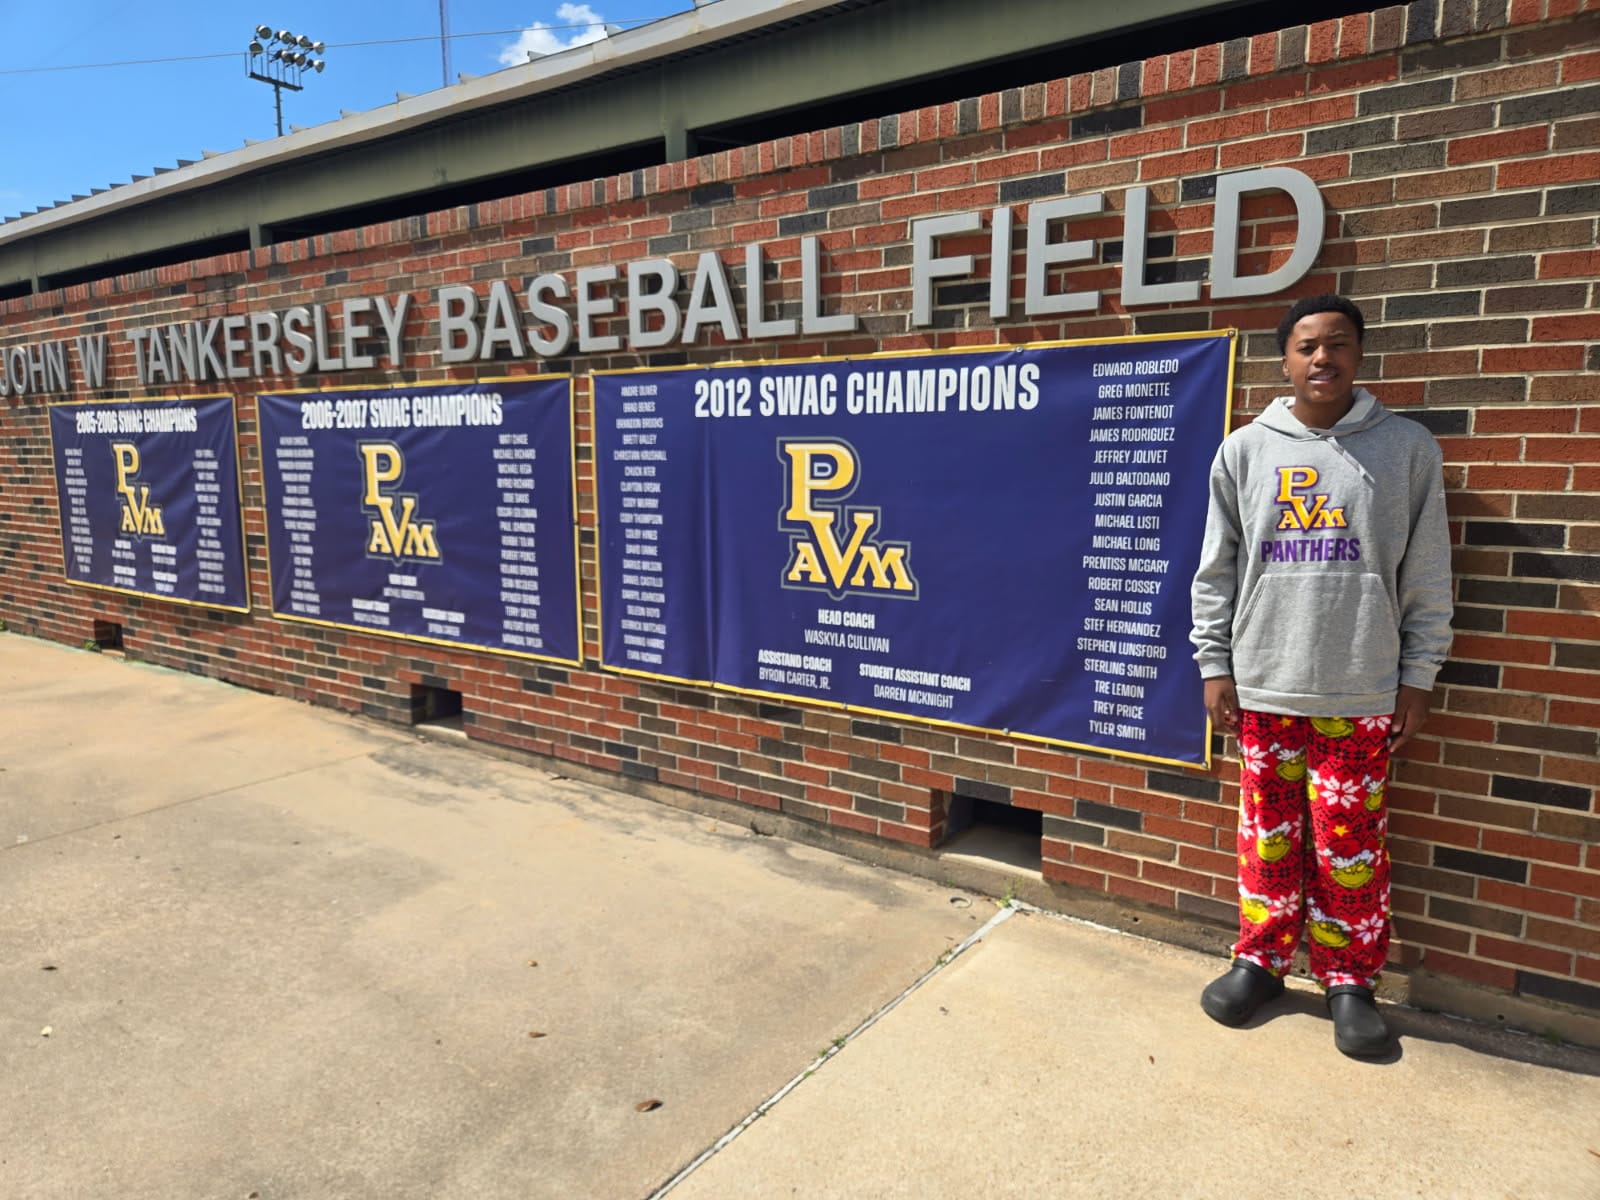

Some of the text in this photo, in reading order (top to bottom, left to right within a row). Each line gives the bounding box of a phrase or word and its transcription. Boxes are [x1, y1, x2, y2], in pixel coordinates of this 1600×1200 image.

[0, 166, 1327, 396] JOHN W TANKERSLEY BASEBALL FIELD
[1093, 358, 1180, 378] EDWARD ROBLEDO
[694, 362, 1041, 418] 2012 SWAC CHAMPIONS
[1099, 382, 1170, 399] GREG MONETTE
[118, 409, 144, 434] SWAC
[144, 407, 198, 433] CHAMPIONS
[301, 392, 503, 430] 2006-2007 SWAC CHAMPIONS
[1093, 404, 1175, 421] JAMES FONTENOT
[1089, 426, 1176, 442] JAMES RODRIGUEZ
[1094, 449, 1168, 464] JEFFREY JOLIVET
[1089, 471, 1171, 486] JULIO BALTODANO
[1094, 492, 1163, 508] JUSTIN GARCIA
[1095, 513, 1160, 530] MICHAEL LISTI
[1093, 534, 1161, 552] MICHAEL LONG
[1261, 538, 1361, 563] PANTHERS
[1083, 555, 1170, 574] PRENTISS MCGARY
[1089, 576, 1162, 595] ROBERT COSSEY
[1095, 597, 1153, 616] SEAN HOLLIS
[818, 608, 876, 630] HEAD COACH
[1084, 617, 1161, 638] STEF HERNANDEZ
[805, 629, 890, 654] WASKYLA CULLIVAN
[1077, 637, 1167, 660] STEPHEN LUNSFORD
[758, 648, 833, 673] ASSISTAND COACH
[1085, 657, 1158, 680] STERLING SMITH
[759, 666, 831, 690] BYRON CARTER, JR.
[859, 662, 972, 692] STUDENT ASSISTANT COACH
[874, 683, 954, 709] DARREN MCKNIGHT
[1095, 679, 1145, 699] TRE LEMON
[1094, 699, 1144, 720] TREY PRICE
[1090, 719, 1146, 741] TYLER SMITH
